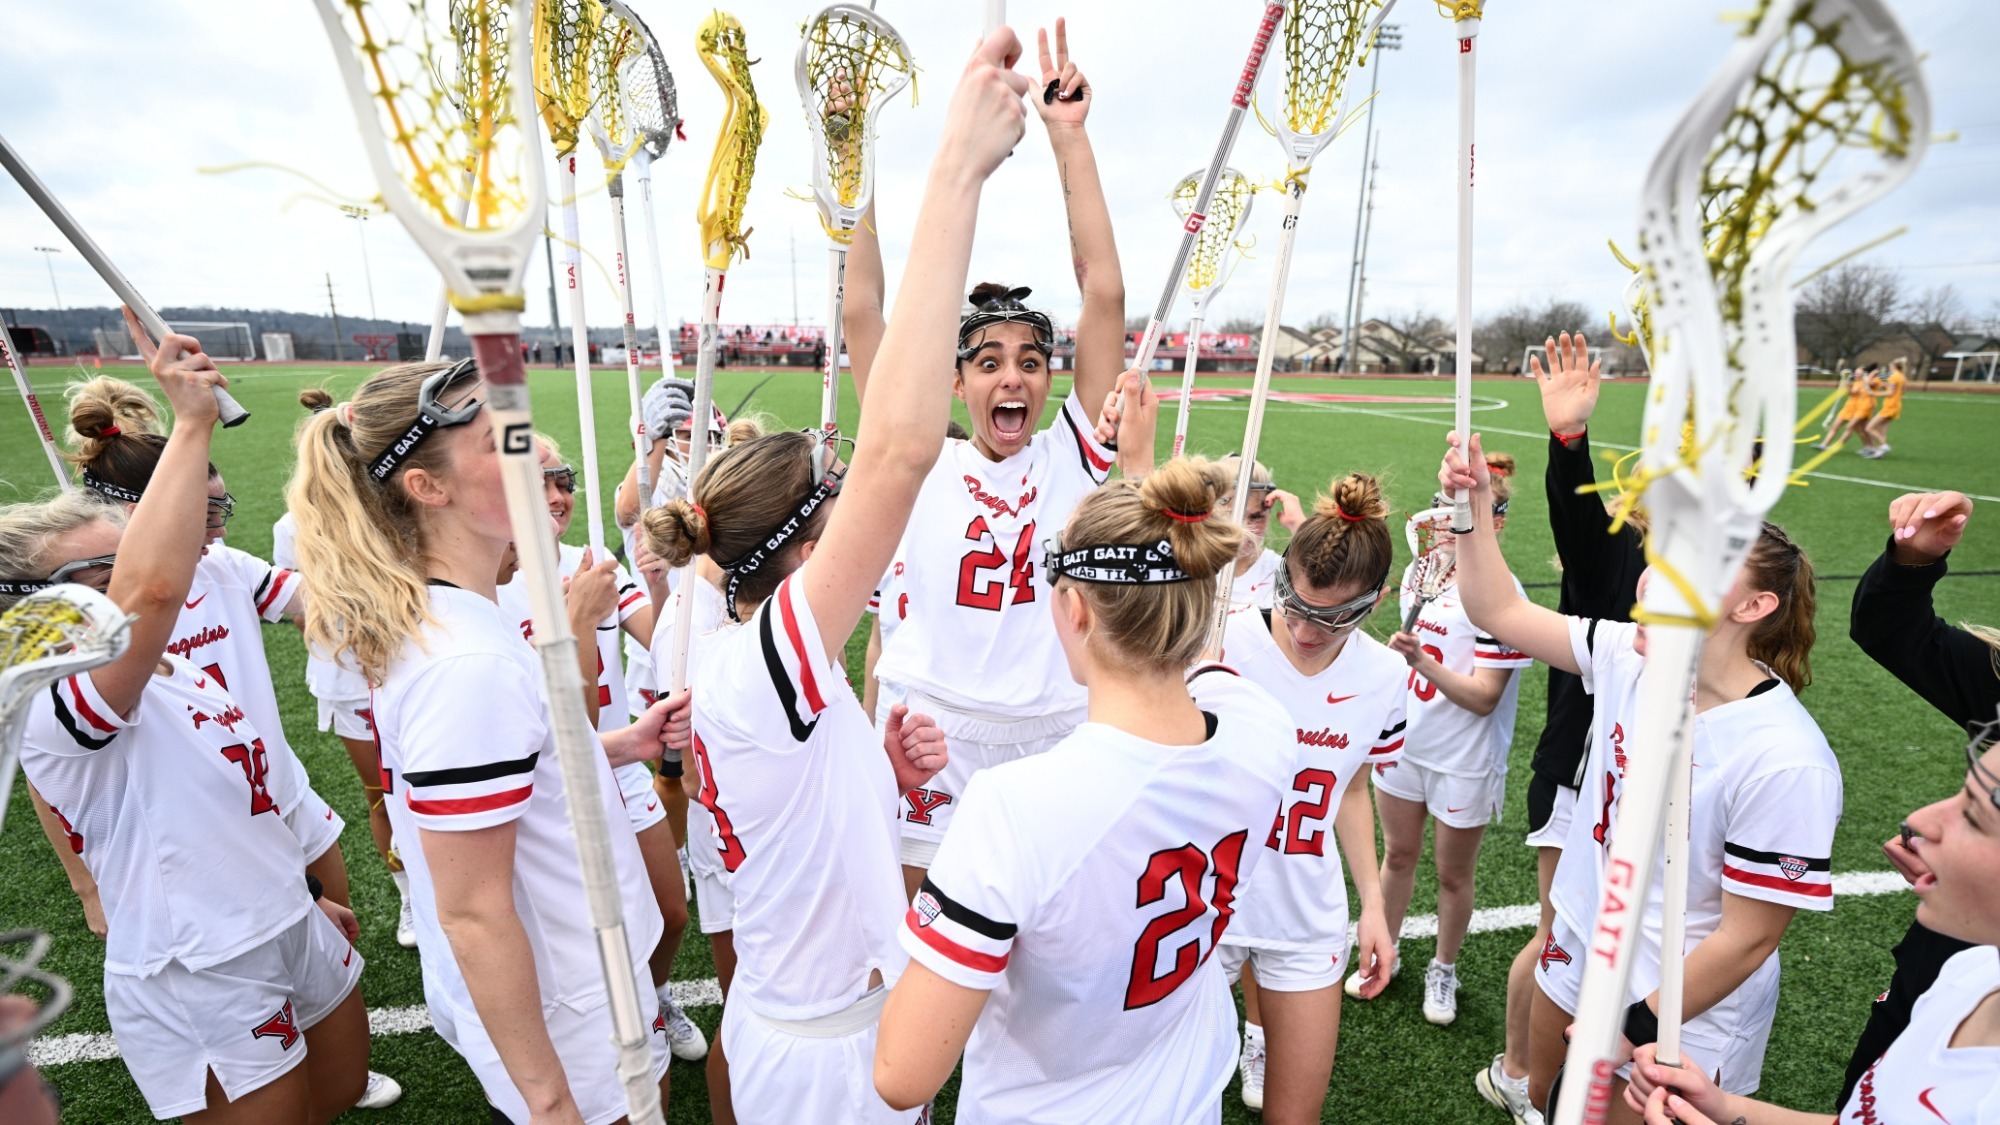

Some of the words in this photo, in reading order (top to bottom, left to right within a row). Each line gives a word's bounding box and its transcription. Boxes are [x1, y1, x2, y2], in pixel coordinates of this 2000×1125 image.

[1231, 2, 1286, 110] PENGUINS
[1460, 38, 1472, 53] 19
[375, 454, 396, 478] GAIT
[394, 425, 423, 456] GAIT
[104, 487, 139, 502] GAIT
[766, 517, 799, 550] GAIT
[1063, 550, 1088, 566] GAIT
[1094, 547, 1137, 560] GAIT
[956, 515, 1036, 612] 24
[905, 787, 943, 826] Y
[1124, 829, 1249, 1012] 21
[1593, 857, 1635, 969] GAIT
[252, 998, 300, 1051] Y
